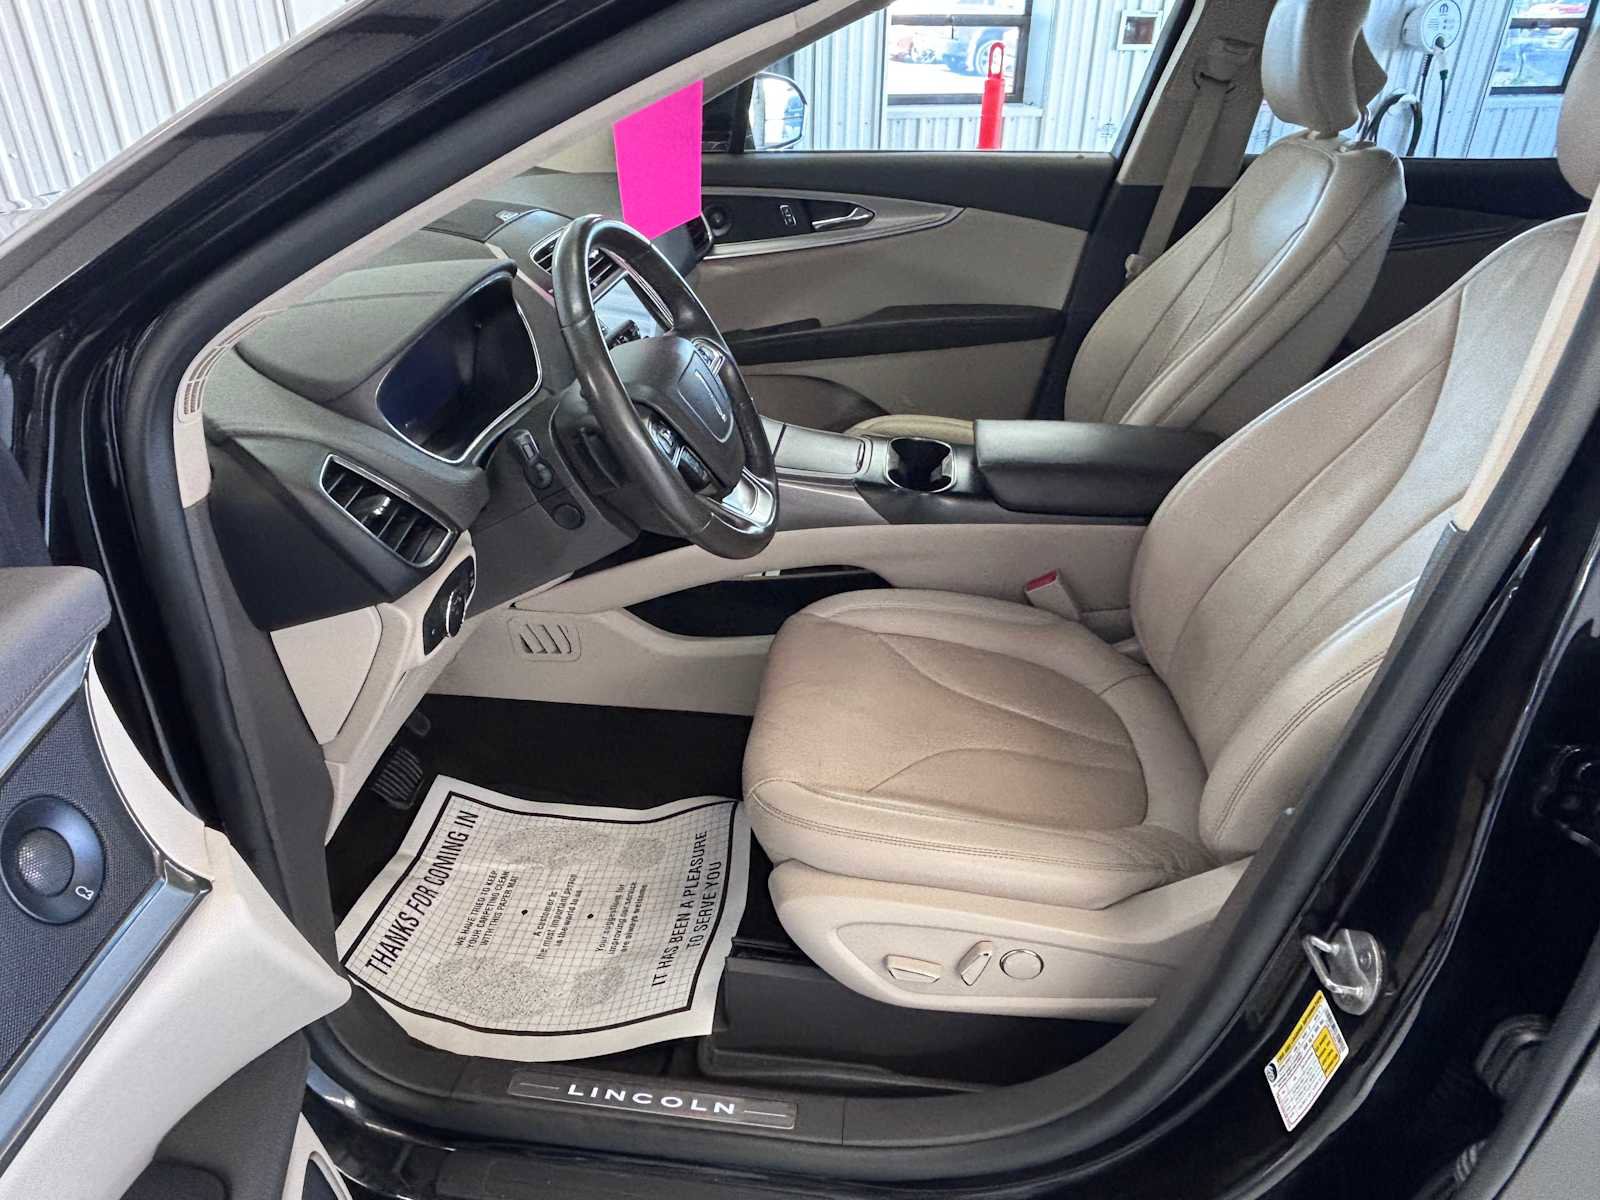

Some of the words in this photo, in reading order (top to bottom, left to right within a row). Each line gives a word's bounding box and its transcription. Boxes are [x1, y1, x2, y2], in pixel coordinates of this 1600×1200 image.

[683, 831, 707, 901] PLEASURE
[706, 861, 722, 890] YOU
[485, 870, 497, 886] KEEP
[365, 911, 420, 975] THANKS
[406, 885, 439, 916] FOR
[424, 831, 469, 886] COMING
[455, 810, 479, 828] IN
[481, 887, 490, 896] TO
[466, 929, 482, 949] YOUR
[476, 892, 500, 928] CARPETING
[495, 871, 510, 891] CLEAN
[471, 897, 485, 915] TRIED
[537, 900, 555, 930] customer
[680, 901, 695, 909] A
[694, 891, 717, 931] SERVE
[461, 916, 475, 935] HAVE
[480, 928, 493, 946] WITH
[489, 912, 503, 926] THIS
[497, 889, 512, 911] PAPER
[669, 913, 691, 945] BEEN
[455, 936, 466, 946] WE
[595, 936, 607, 952] Your
[687, 934, 704, 950] TO
[657, 946, 679, 969] HAS
[652, 974, 668, 987] IT
[568, 1084, 736, 1115] LINCOLN
